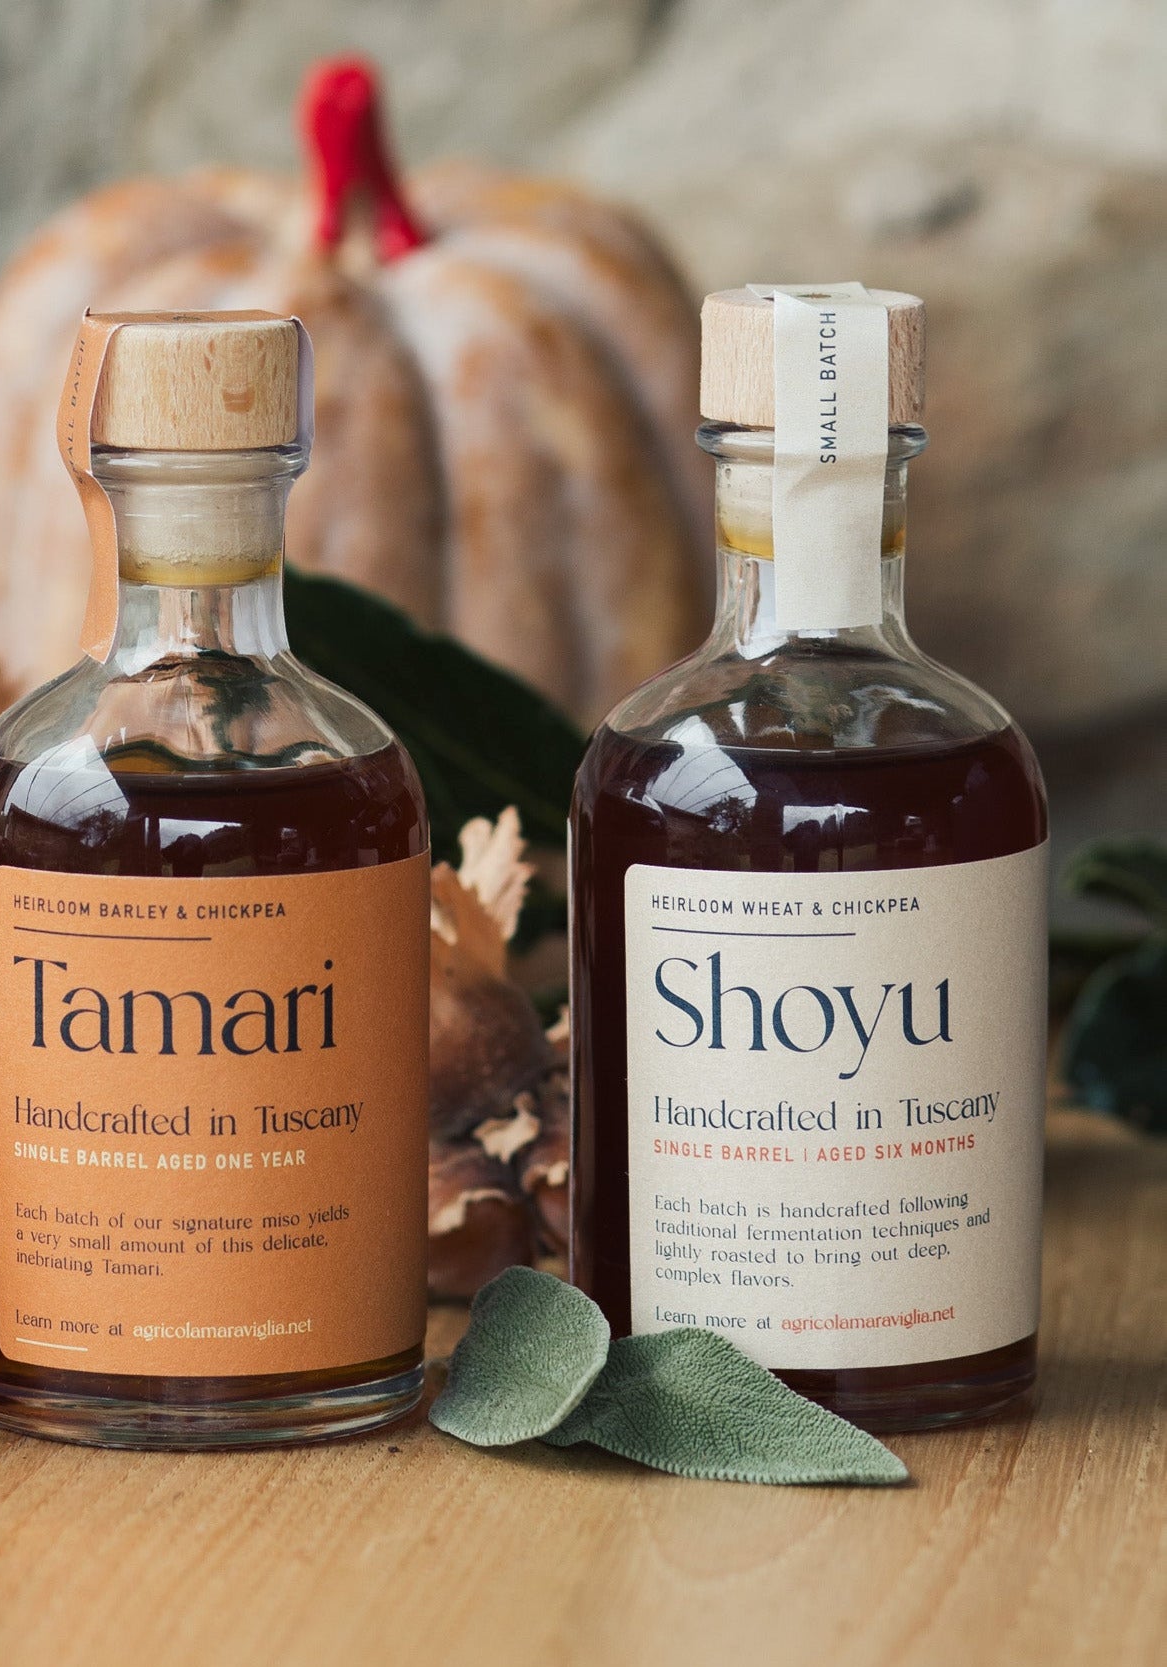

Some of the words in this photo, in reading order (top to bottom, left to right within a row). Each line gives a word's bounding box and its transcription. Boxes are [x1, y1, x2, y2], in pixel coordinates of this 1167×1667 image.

[820, 312, 836, 381] BATCH
[71, 339, 86, 407] BATCH
[820, 392, 836, 464] SMALL
[13, 895, 91, 917] HEIRLOOM
[99, 903, 167, 920] BARLEY
[177, 905, 188, 920] &
[197, 903, 286, 920] CHICKPEA
[652, 895, 734, 914] HEIRLOOM
[742, 901, 804, 916] WHEAT
[812, 902, 823, 916] &
[832, 897, 920, 915] CHICKPEA
[13, 955, 337, 1056] Tamari
[654, 951, 953, 1080] Shoyu
[14, 1095, 191, 1136] Handcrafted
[209, 1108, 236, 1136] in
[254, 1101, 364, 1133] Tuscany
[654, 1095, 836, 1132] Handcrafted
[856, 1102, 882, 1130] in
[899, 1091, 1001, 1127] Tuscany
[13, 1142, 70, 1164] SINGLE
[77, 1150, 149, 1170] BARREL
[157, 1154, 208, 1170] AGED
[215, 1152, 254, 1170] ONE
[261, 1149, 306, 1167] YEAR
[654, 1139, 713, 1159] SINGLE
[722, 1146, 794, 1162] BARREL
[817, 1146, 866, 1162] AGED
[875, 1143, 903, 1159] SIX
[911, 1134, 975, 1157] MONTHS
[16, 1202, 47, 1222] Each
[55, 1207, 99, 1227] batch
[108, 1212, 126, 1228] of
[133, 1217, 163, 1230] our
[172, 1214, 253, 1234] signature
[262, 1213, 300, 1228] miso
[308, 1204, 350, 1229] yields
[655, 1195, 691, 1213] Each
[700, 1199, 747, 1217] batch
[757, 1204, 771, 1217] is
[781, 1200, 890, 1218] handcrafted
[900, 1193, 969, 1214] following
[655, 1219, 737, 1239] traditional
[747, 1225, 862, 1241] fermentation
[873, 1219, 959, 1238] techniques
[966, 1208, 991, 1228] and
[16, 1229, 24, 1241] a
[30, 1230, 61, 1250] very
[69, 1235, 111, 1251] small
[120, 1239, 186, 1254] amount
[195, 1237, 214, 1254] of
[223, 1235, 254, 1254] this
[655, 1239, 702, 1263] lightly
[711, 1248, 776, 1264] roasted
[787, 1251, 804, 1264] to
[815, 1249, 861, 1267] bring
[871, 1247, 899, 1262] out
[16, 1249, 93, 1277] inebriating
[103, 1258, 164, 1277] Tamari.
[655, 1267, 722, 1286] complex
[732, 1270, 794, 1288] flavors.
[16, 1309, 52, 1330] Learn
[60, 1319, 99, 1335] more
[108, 1323, 123, 1336] at
[133, 1318, 313, 1341] agricolamaraviglia.net
[655, 1306, 696, 1325] Learn
[705, 1315, 747, 1329] more
[756, 1317, 771, 1330] at
[781, 1305, 956, 1334] agricolamaraviglia.net
